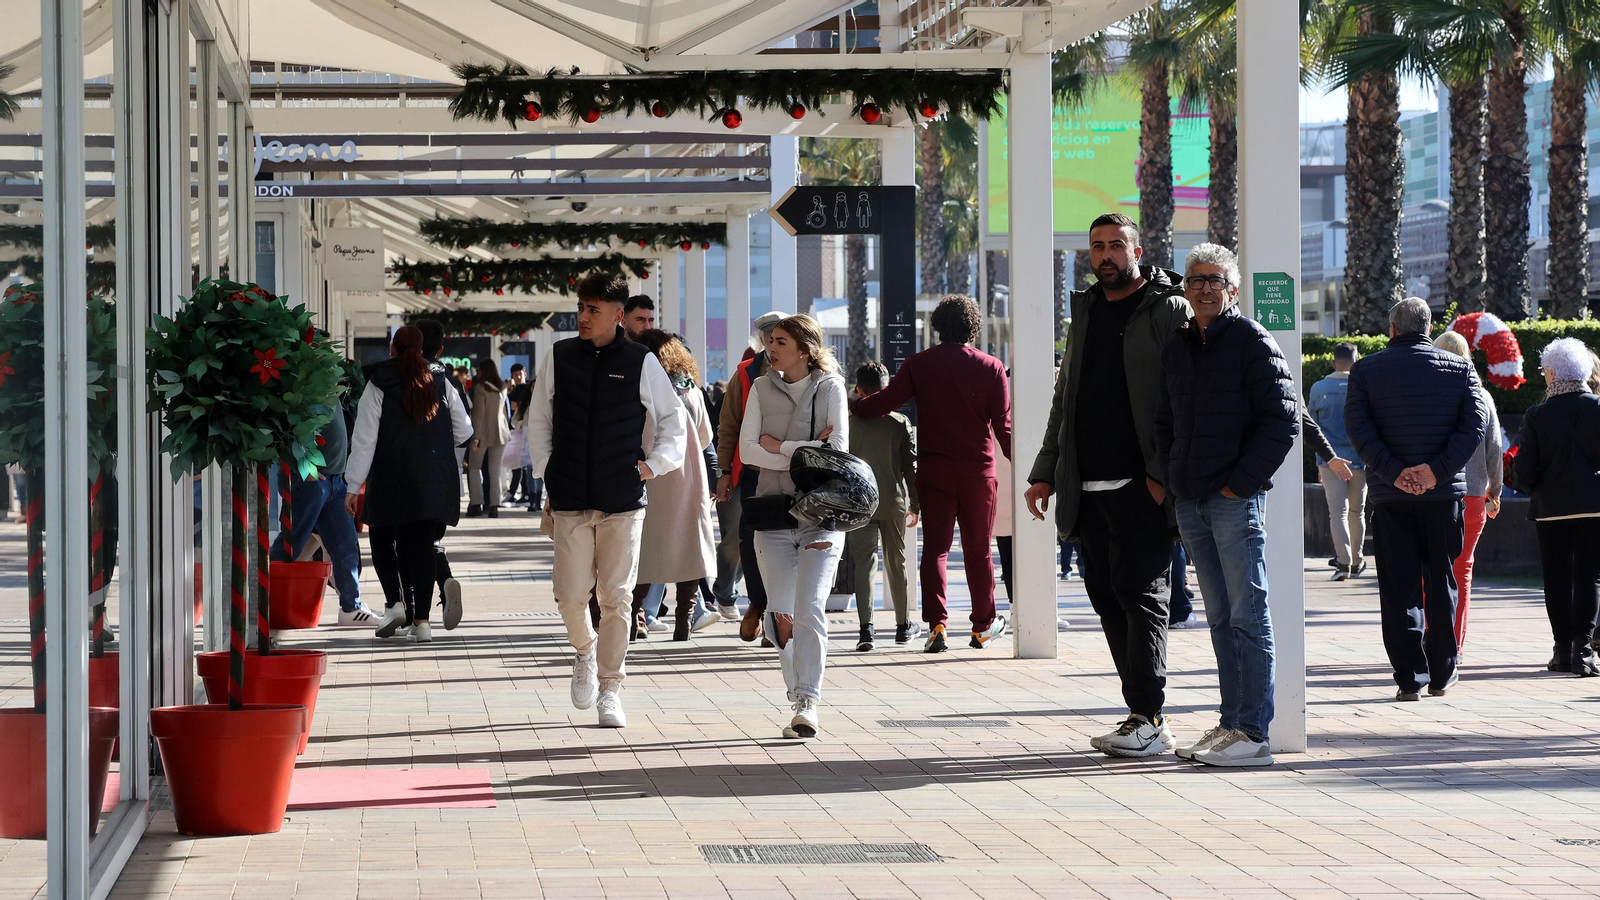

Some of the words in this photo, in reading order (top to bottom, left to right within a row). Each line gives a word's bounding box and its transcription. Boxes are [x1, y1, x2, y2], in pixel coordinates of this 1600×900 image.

[1063, 119, 1081, 130] de
[1093, 135, 1111, 145] en
[1064, 148, 1095, 160] web
[351, 246, 375, 257] Jeans
